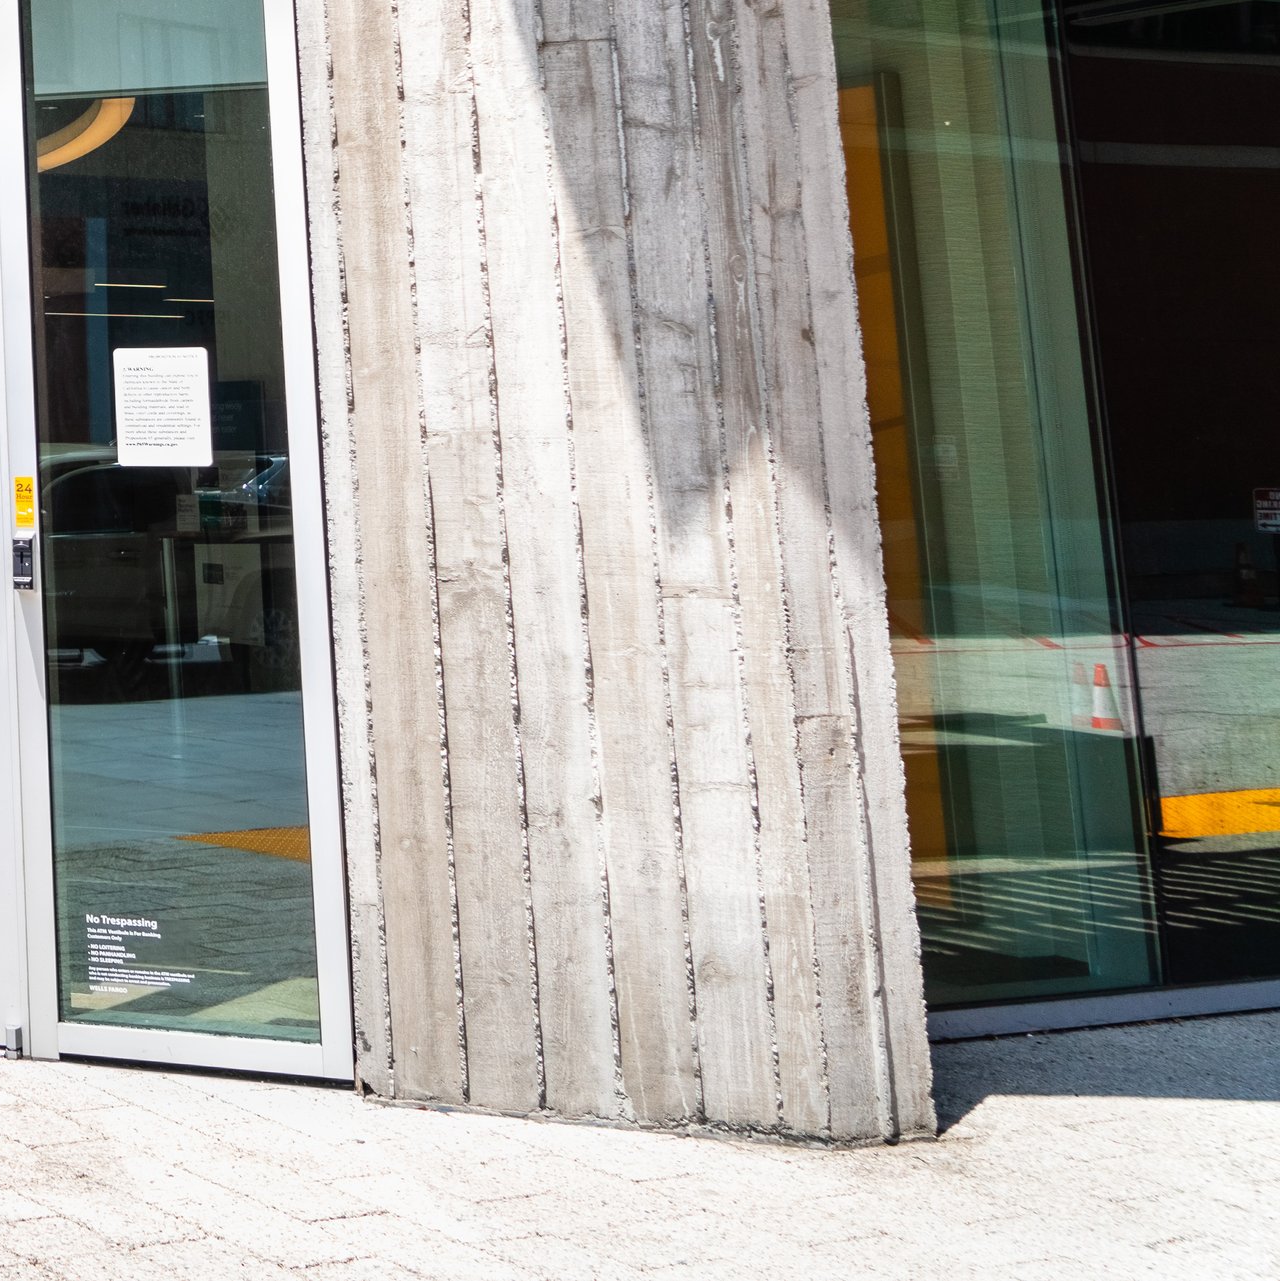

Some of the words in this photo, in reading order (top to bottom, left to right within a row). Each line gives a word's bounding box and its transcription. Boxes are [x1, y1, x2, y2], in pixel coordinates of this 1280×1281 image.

[16, 484, 32, 493] 24
[86, 914, 100, 924] No
[100, 915, 157, 930] Trespassing
